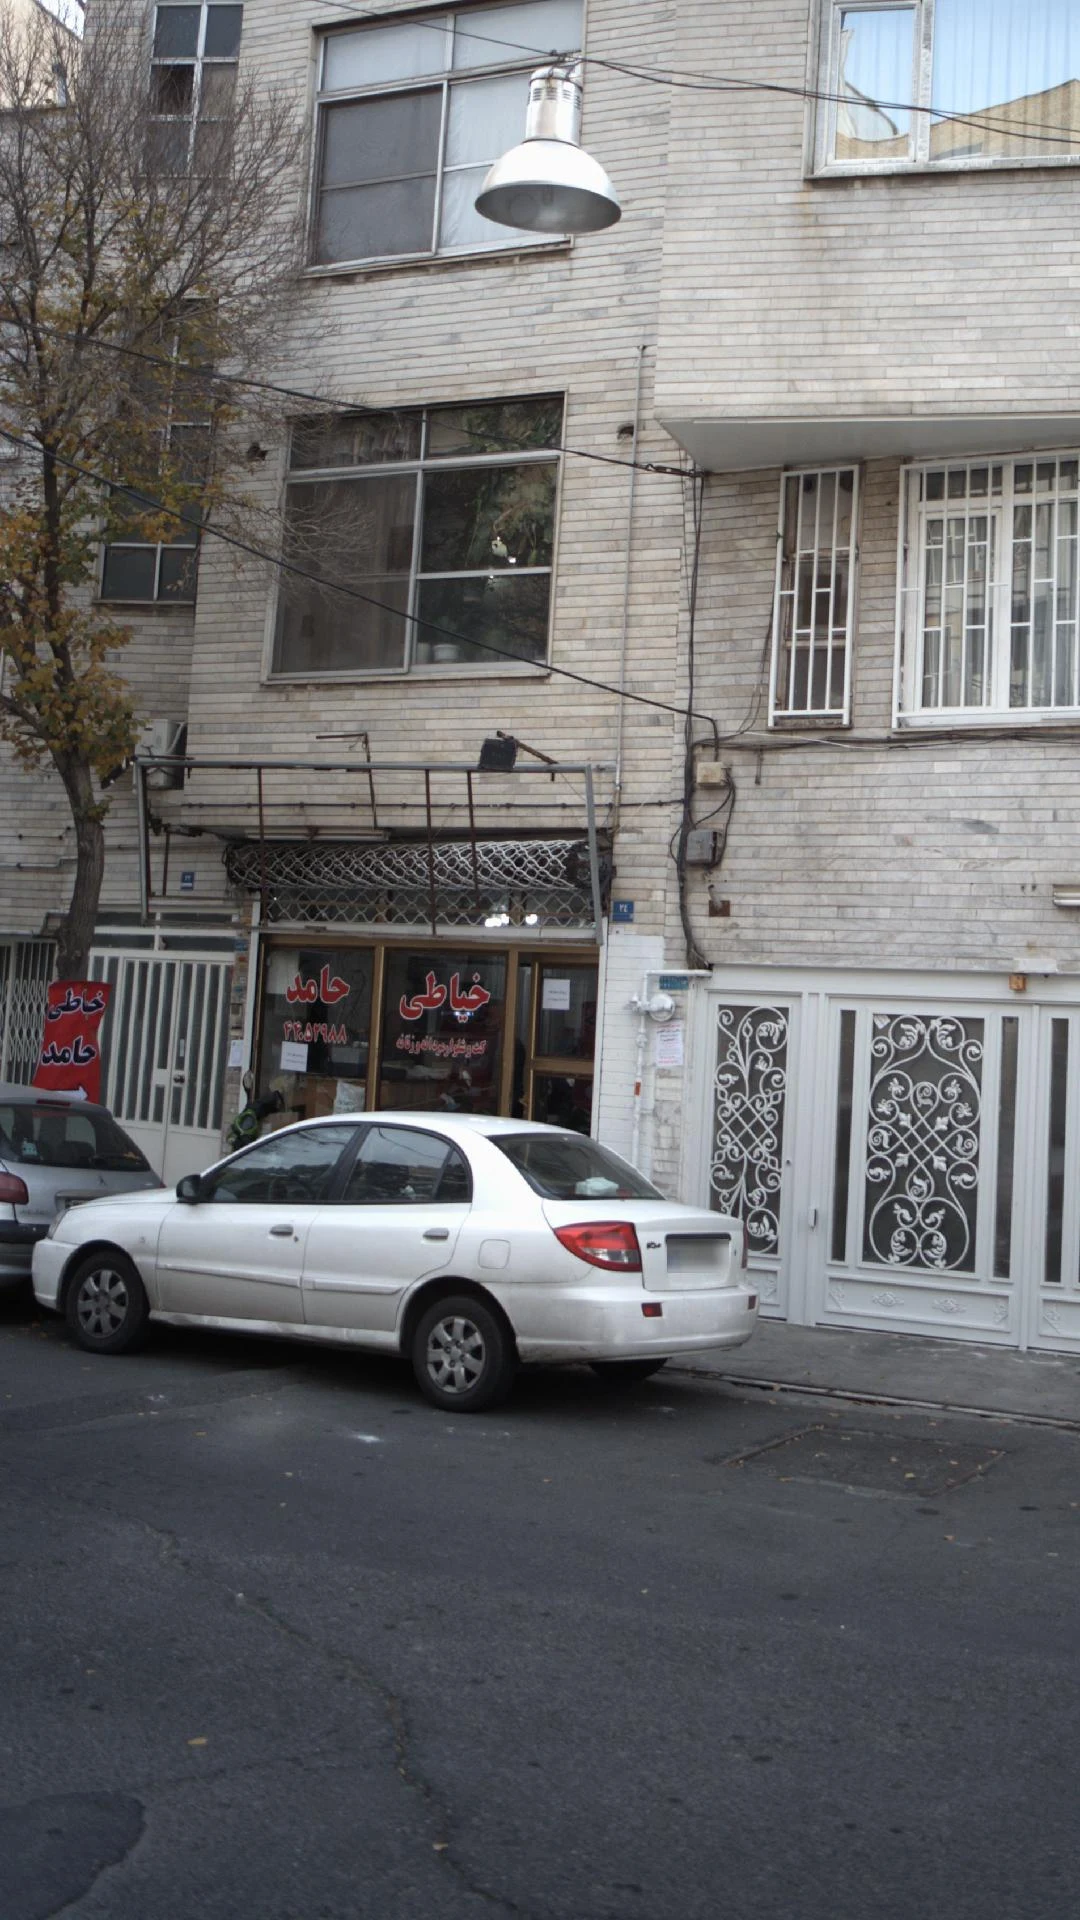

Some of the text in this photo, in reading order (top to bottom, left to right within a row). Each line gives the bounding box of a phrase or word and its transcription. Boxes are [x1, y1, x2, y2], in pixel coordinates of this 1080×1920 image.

[286, 964, 351, 1004] حامد
[399, 971, 491, 1023] خیاطی
[41, 1036, 96, 1065] حامد
